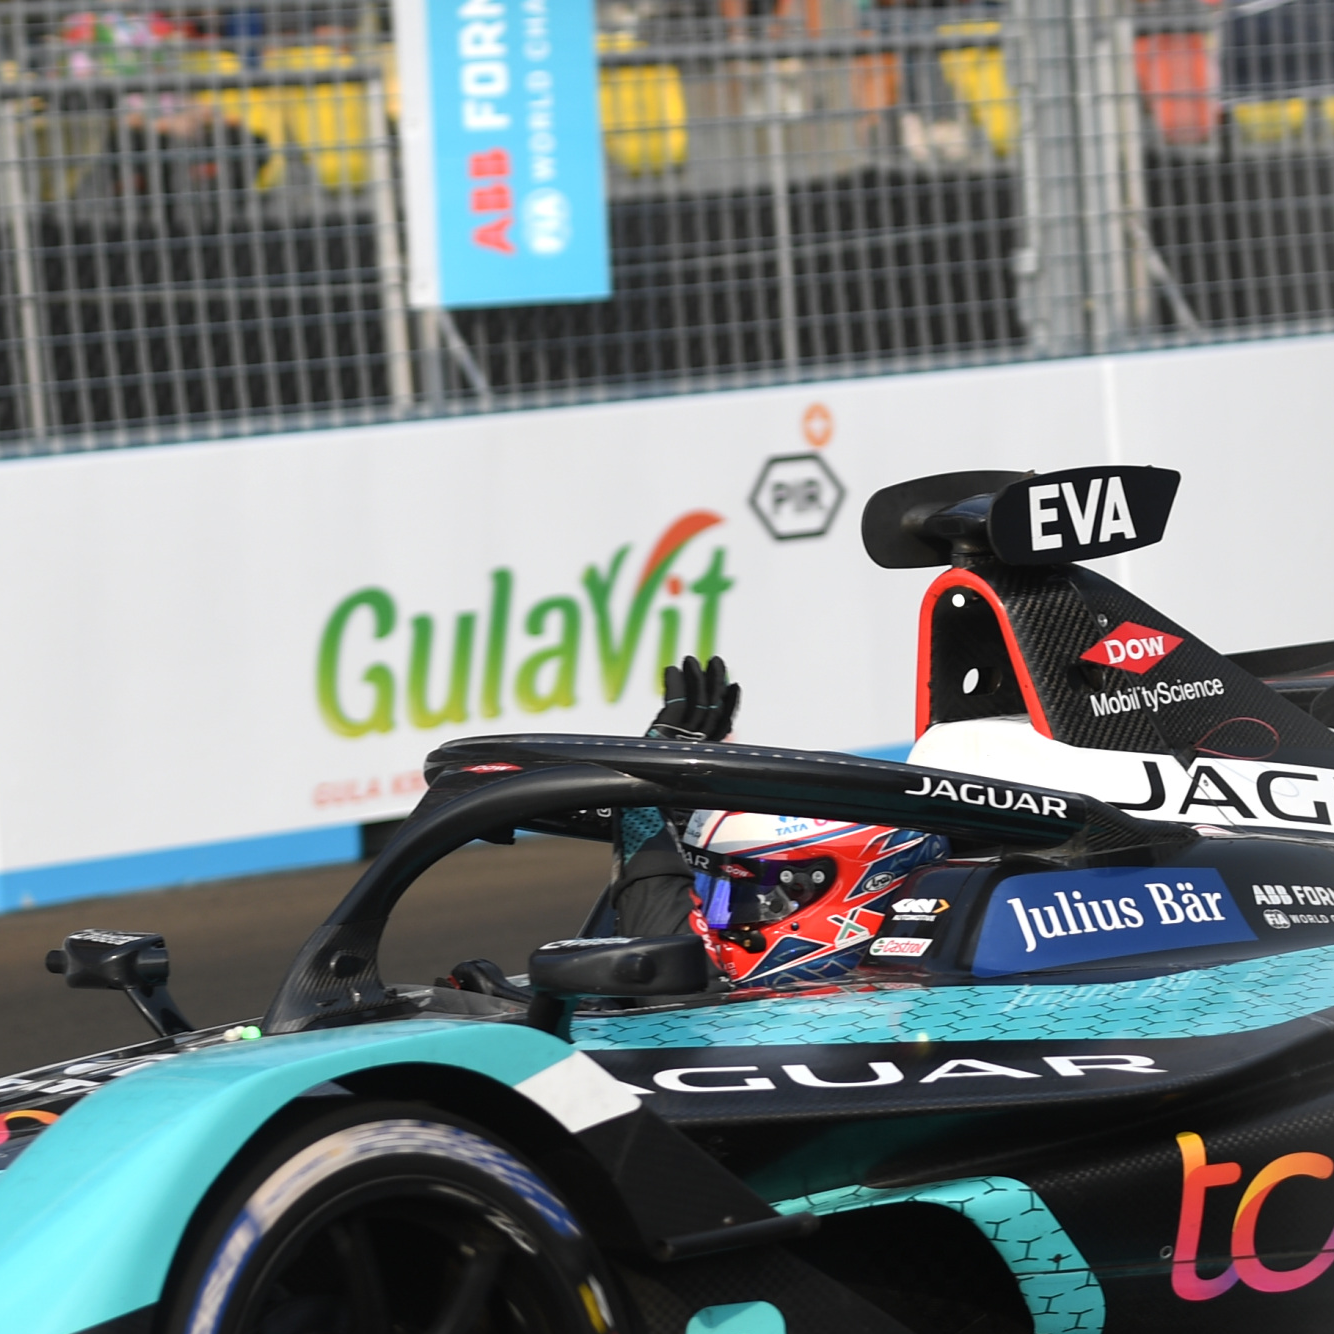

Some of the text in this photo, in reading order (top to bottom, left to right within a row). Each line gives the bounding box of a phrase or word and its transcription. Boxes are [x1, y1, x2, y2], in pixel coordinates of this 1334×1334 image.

[524, 70, 558, 182] WORLD
[467, 148, 516, 254] ABB
[771, 480, 824, 515] PIR
[1028, 476, 1138, 551] EVA
[316, 509, 737, 738] GulaVit
[905, 776, 1067, 819] JAGUAR
[775, 823, 809, 836] TATA
[1252, 885, 1293, 905] ABB
[1006, 881, 1227, 953] Julius Bär
[1290, 914, 1329, 924] WORLD
[883, 940, 927, 954] Castrol
